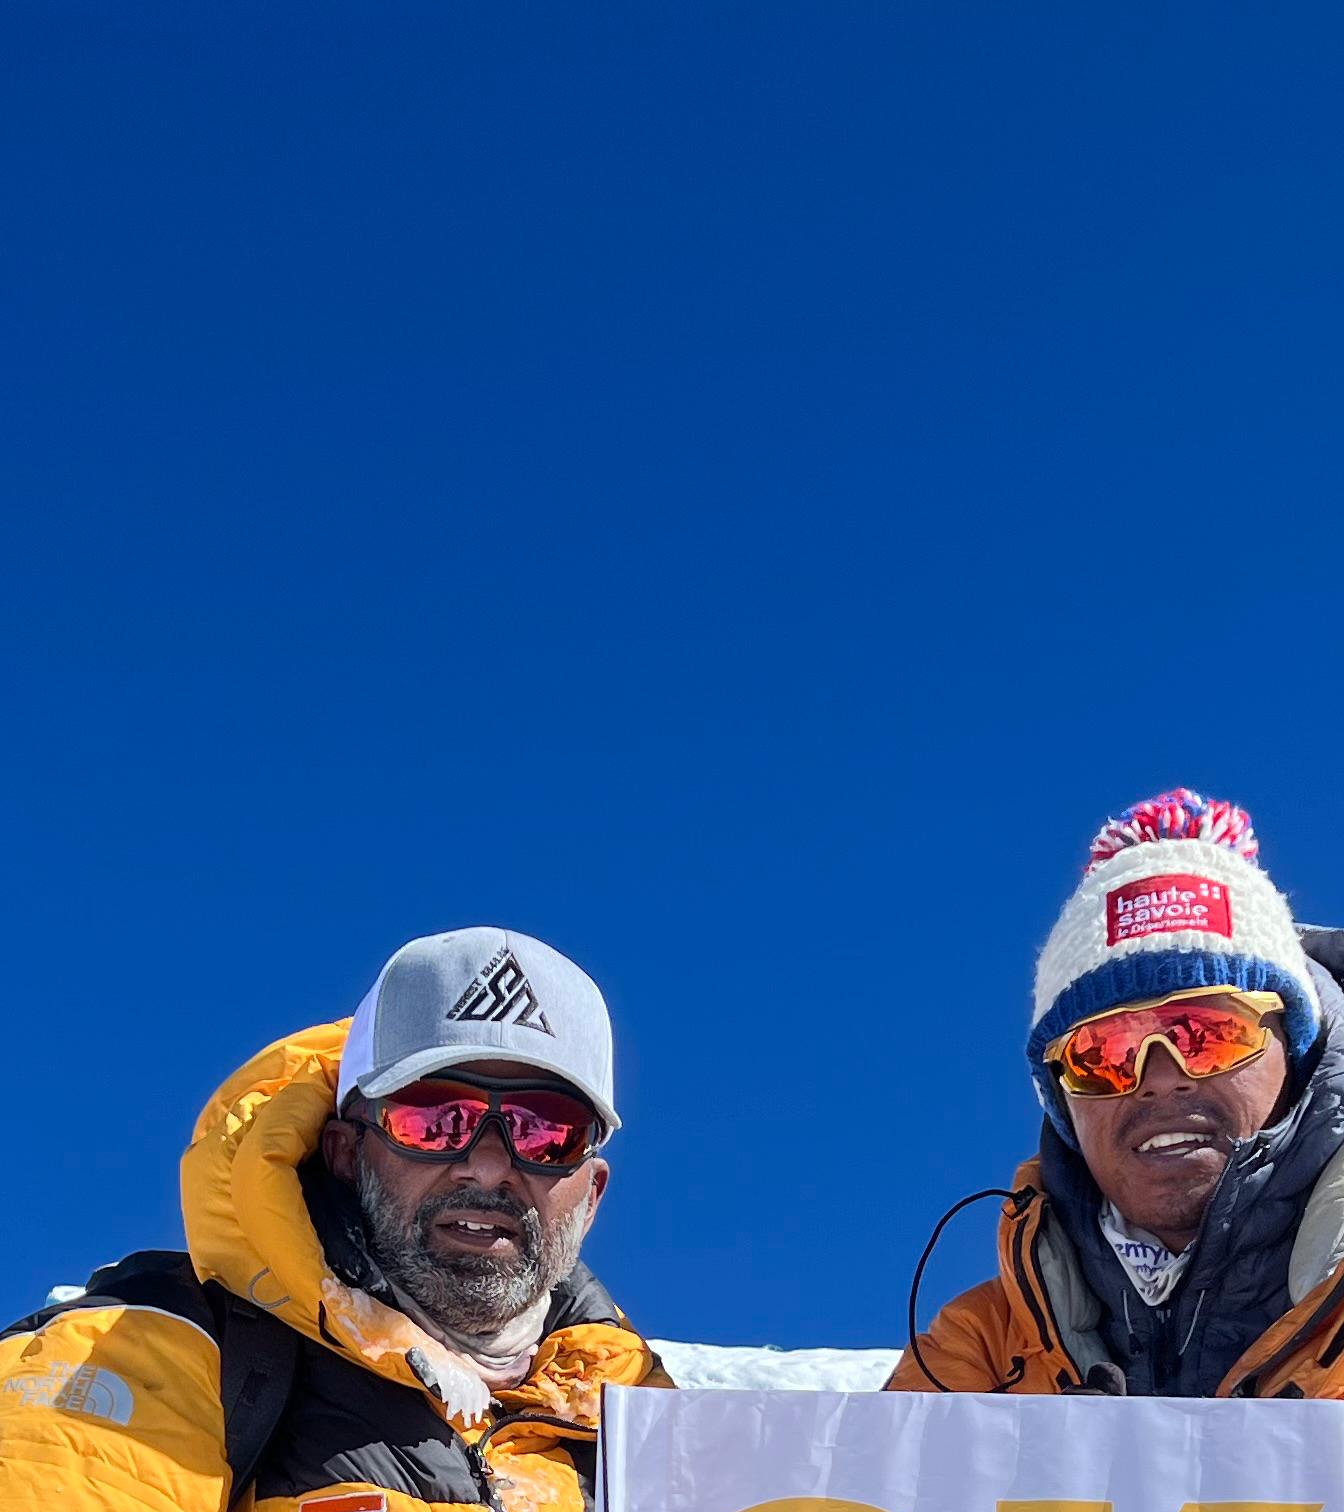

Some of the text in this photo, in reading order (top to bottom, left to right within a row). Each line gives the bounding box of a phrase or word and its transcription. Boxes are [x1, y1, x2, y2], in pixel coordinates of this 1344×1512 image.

[1117, 885, 1197, 914] haute
[1118, 903, 1209, 927] savoie
[1117, 927, 1129, 938] le
[48, 1360, 97, 1381] THE
[19, 1391, 82, 1411] FACE
